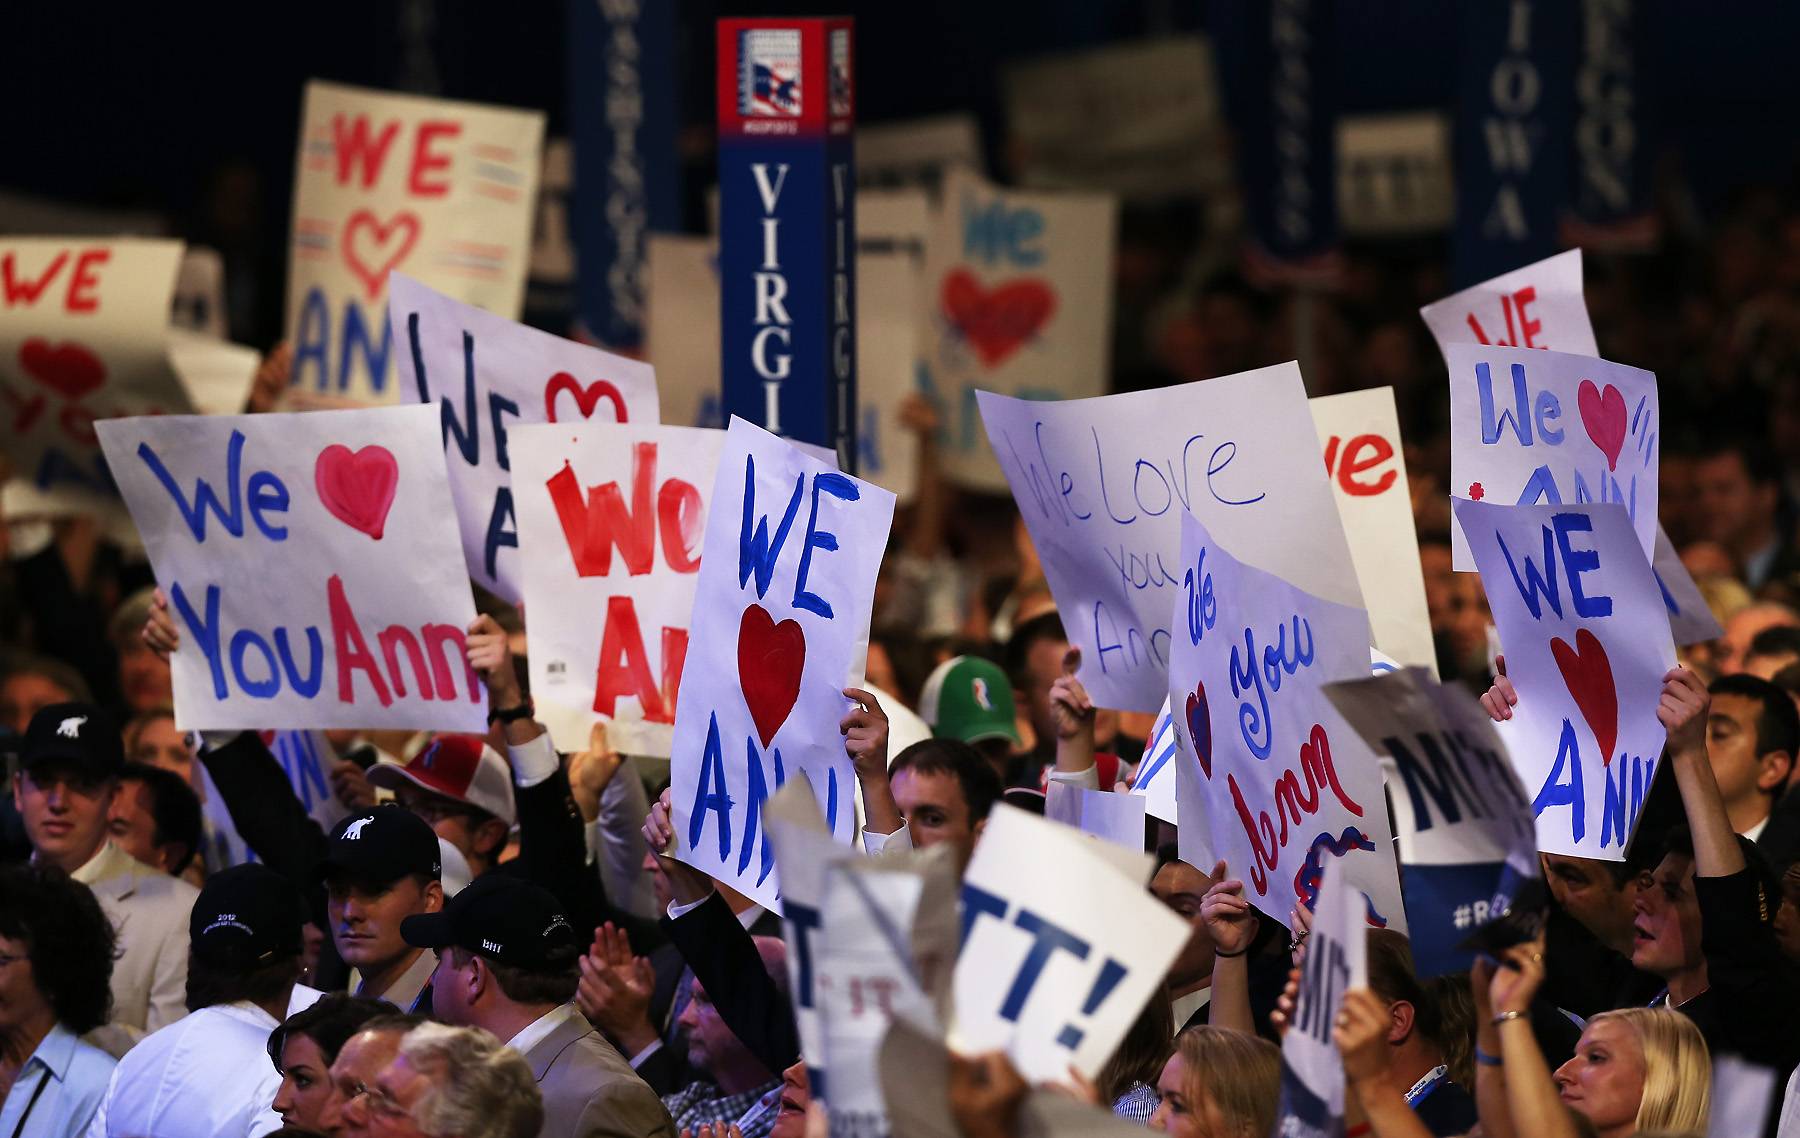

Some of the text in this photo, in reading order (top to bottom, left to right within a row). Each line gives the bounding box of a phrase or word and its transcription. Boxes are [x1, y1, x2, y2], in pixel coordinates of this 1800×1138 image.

[332, 113, 462, 197] WE
[0, 250, 111, 313] WE
[1475, 362, 1565, 447] We
[137, 429, 291, 544] We
[545, 441, 703, 577] We
[738, 453, 861, 620] WE
[1496, 512, 1613, 622] WE
